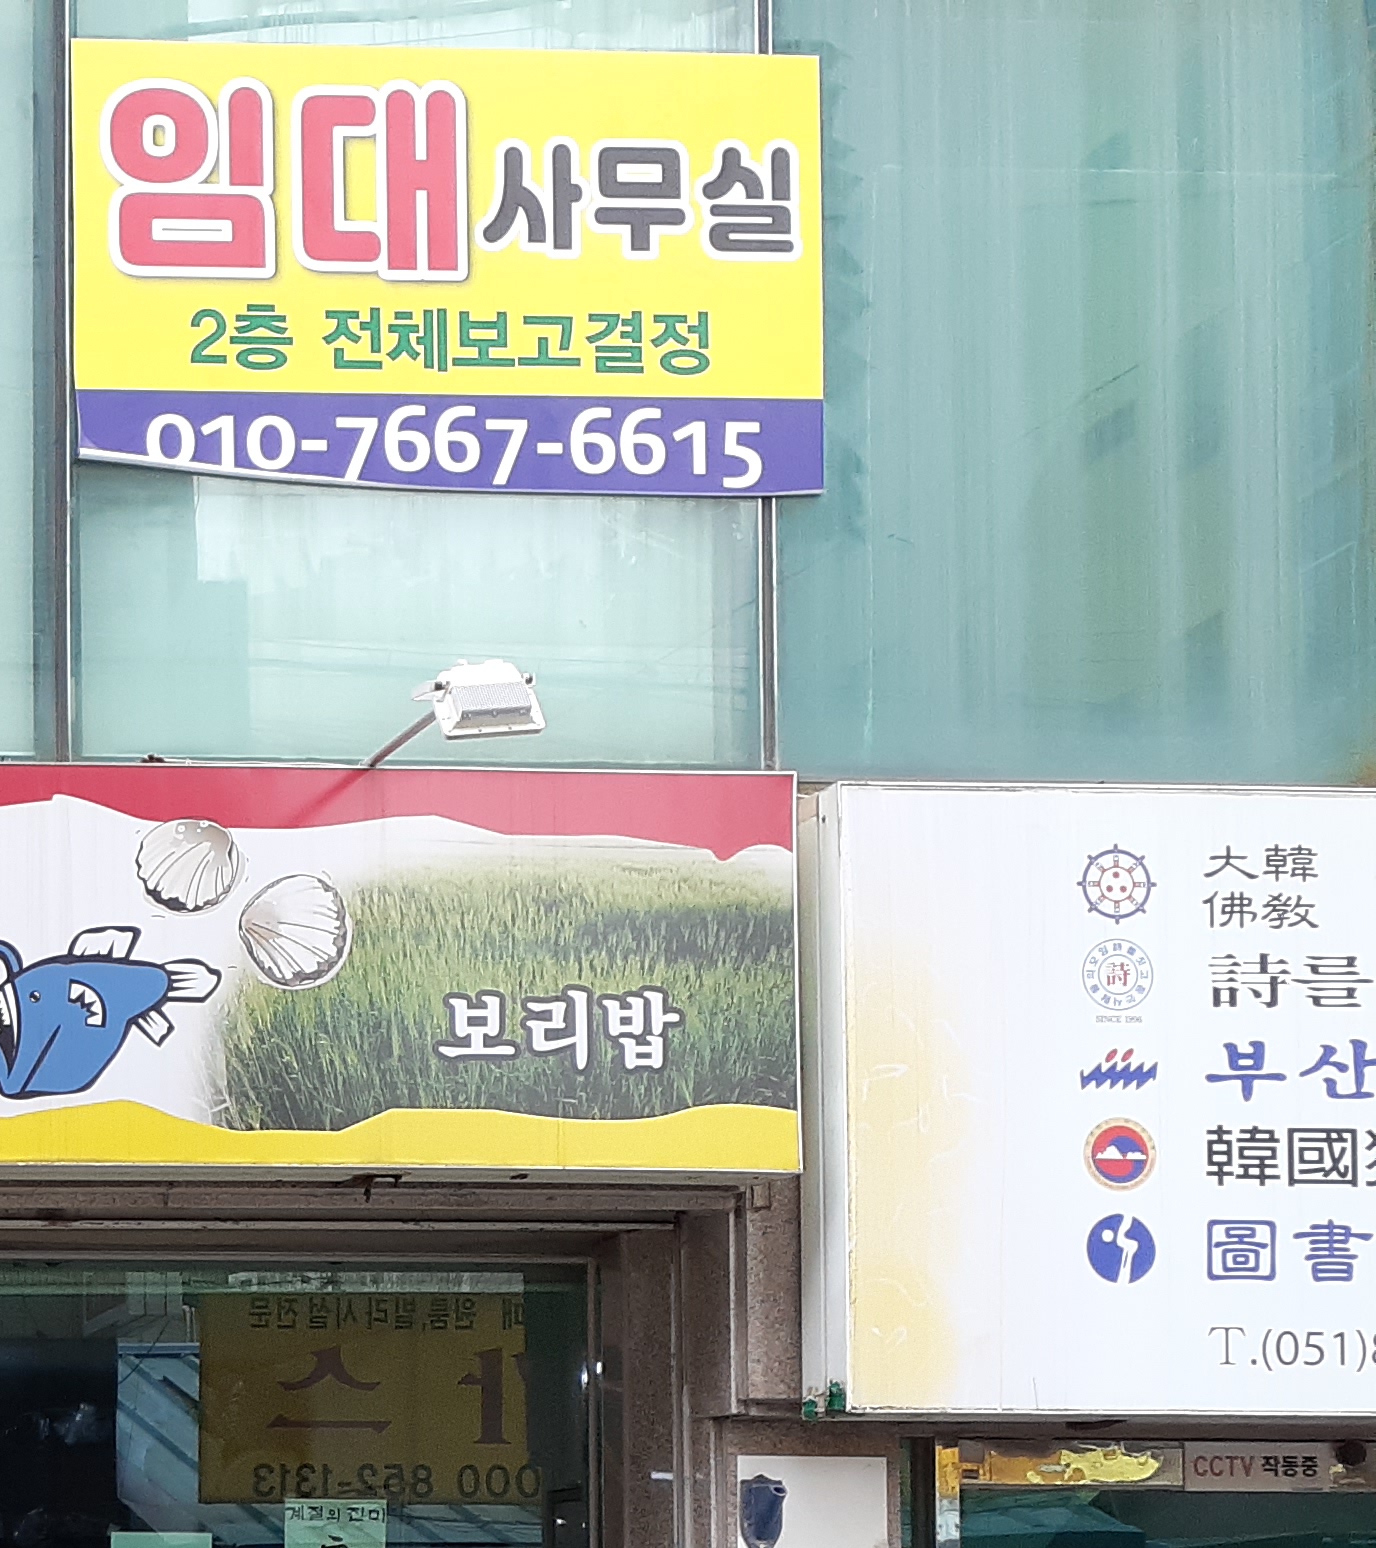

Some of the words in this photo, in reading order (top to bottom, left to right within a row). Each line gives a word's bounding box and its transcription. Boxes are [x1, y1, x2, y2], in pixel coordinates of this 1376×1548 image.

[102, 80, 465, 279] 임대
[482, 140, 798, 257] 사무실
[189, 303, 294, 373] 2층
[321, 306, 713, 376] 전체보고결정
[145, 404, 766, 490] 010-7667-6615
[1202, 843, 1320, 883] 大韓
[1209, 952, 1375, 1009] 詩를
[436, 984, 681, 1074] 보리밥
[1205, 1218, 1376, 1283] 圖書
[1193, 1455, 1255, 1478] CCTV
[1261, 1454, 1319, 1479] 작동중
